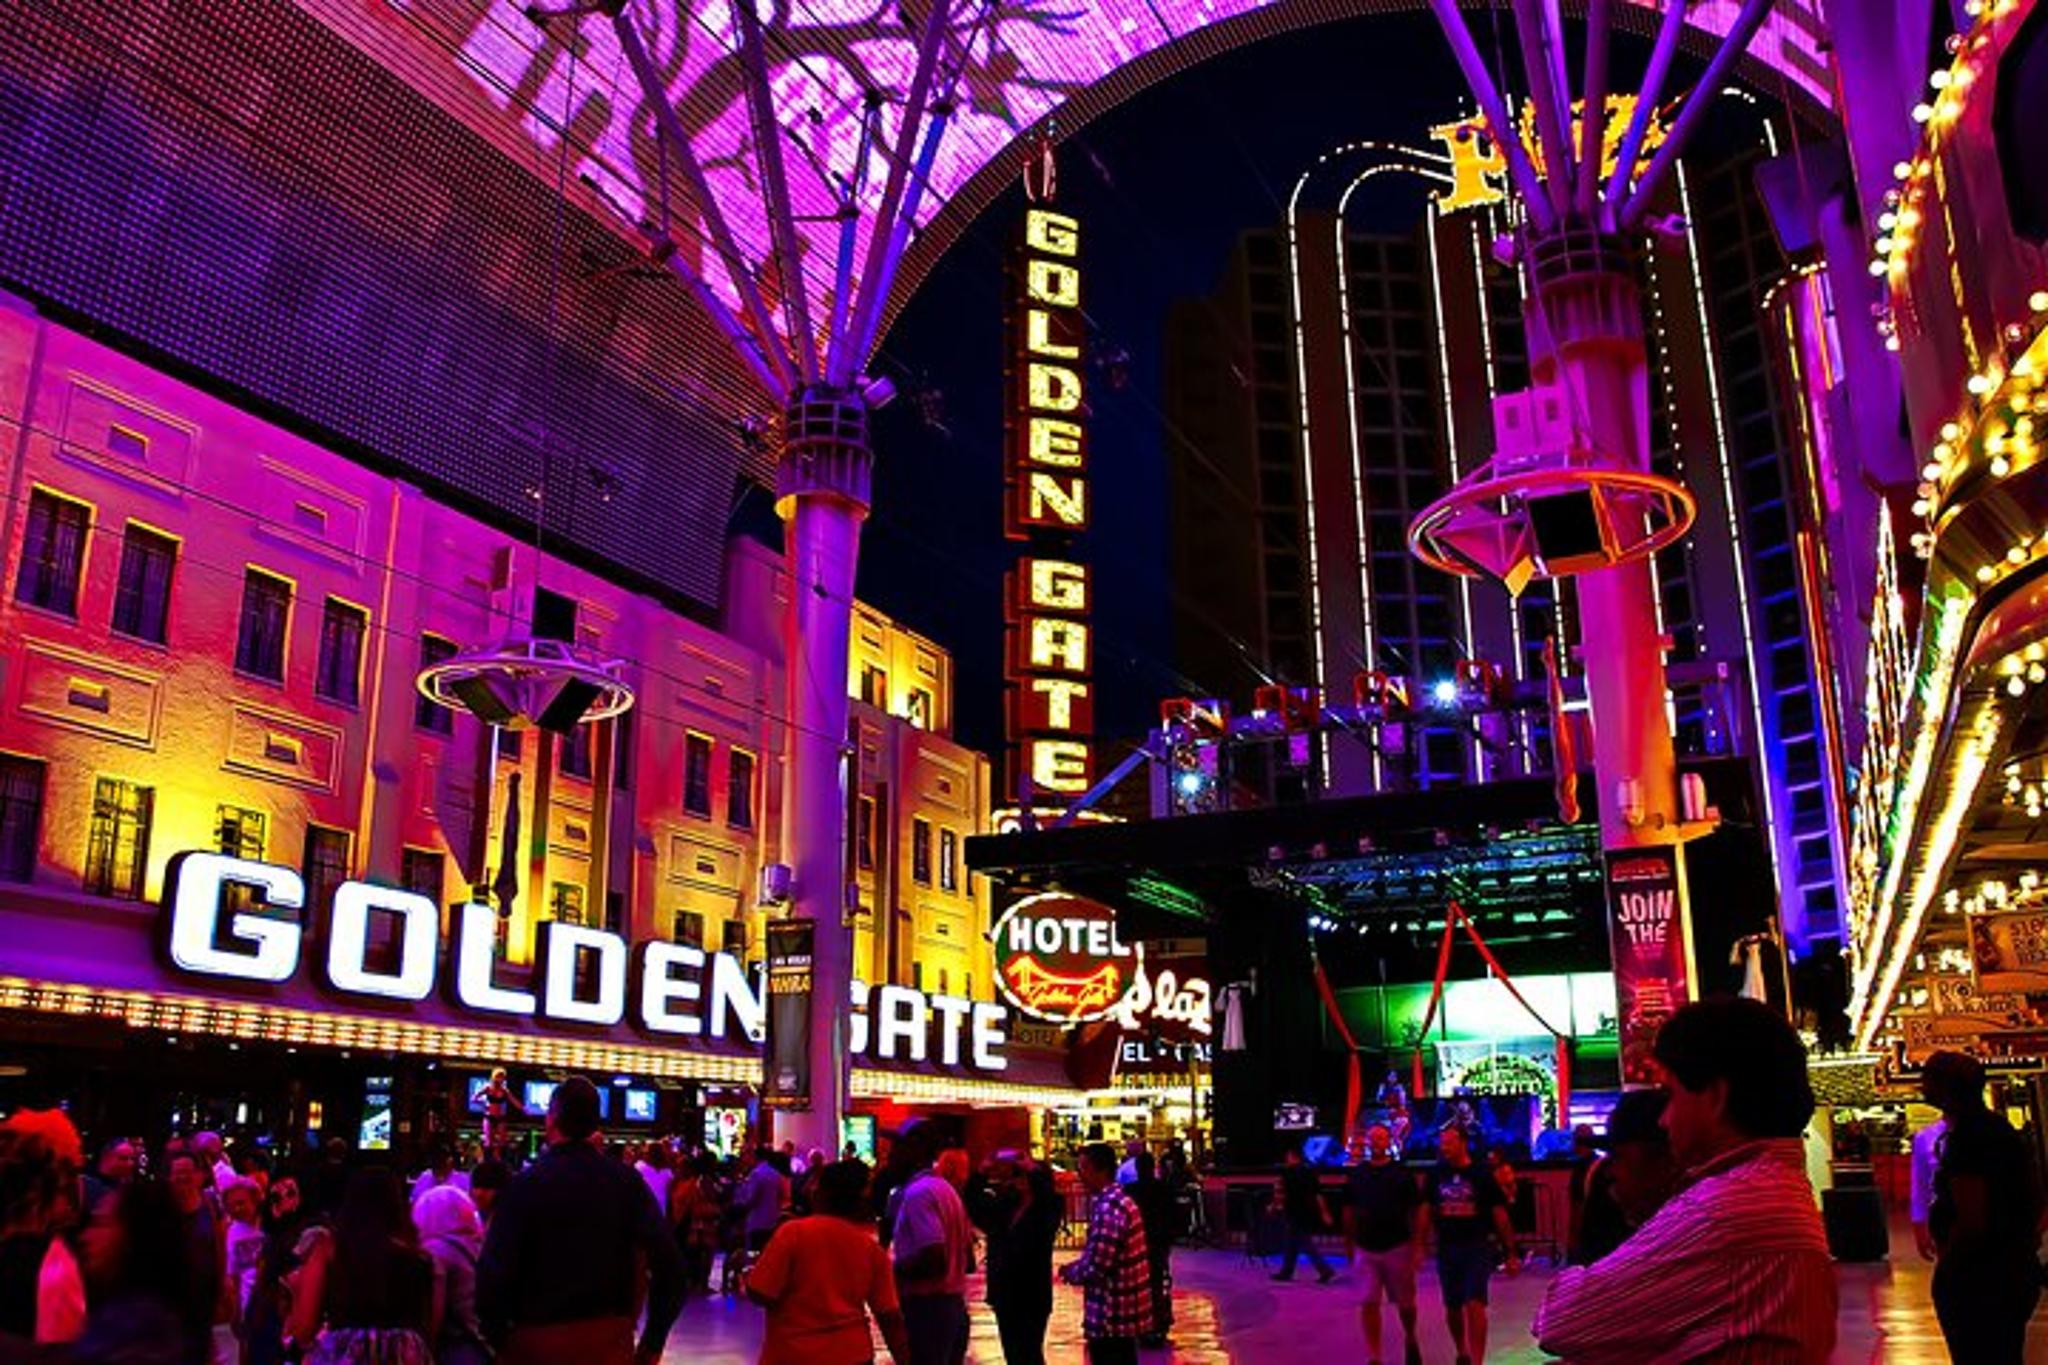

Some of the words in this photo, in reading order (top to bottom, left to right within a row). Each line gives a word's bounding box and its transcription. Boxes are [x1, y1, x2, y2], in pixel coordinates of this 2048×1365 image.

[1026, 209, 1085, 525] GOLDEN
[1031, 559, 1088, 792] GATE
[170, 851, 766, 1044] GOLDEN
[1009, 917, 1132, 957] HOTEL
[1617, 889, 1675, 923] JOIN
[1624, 921, 1667, 945] THE
